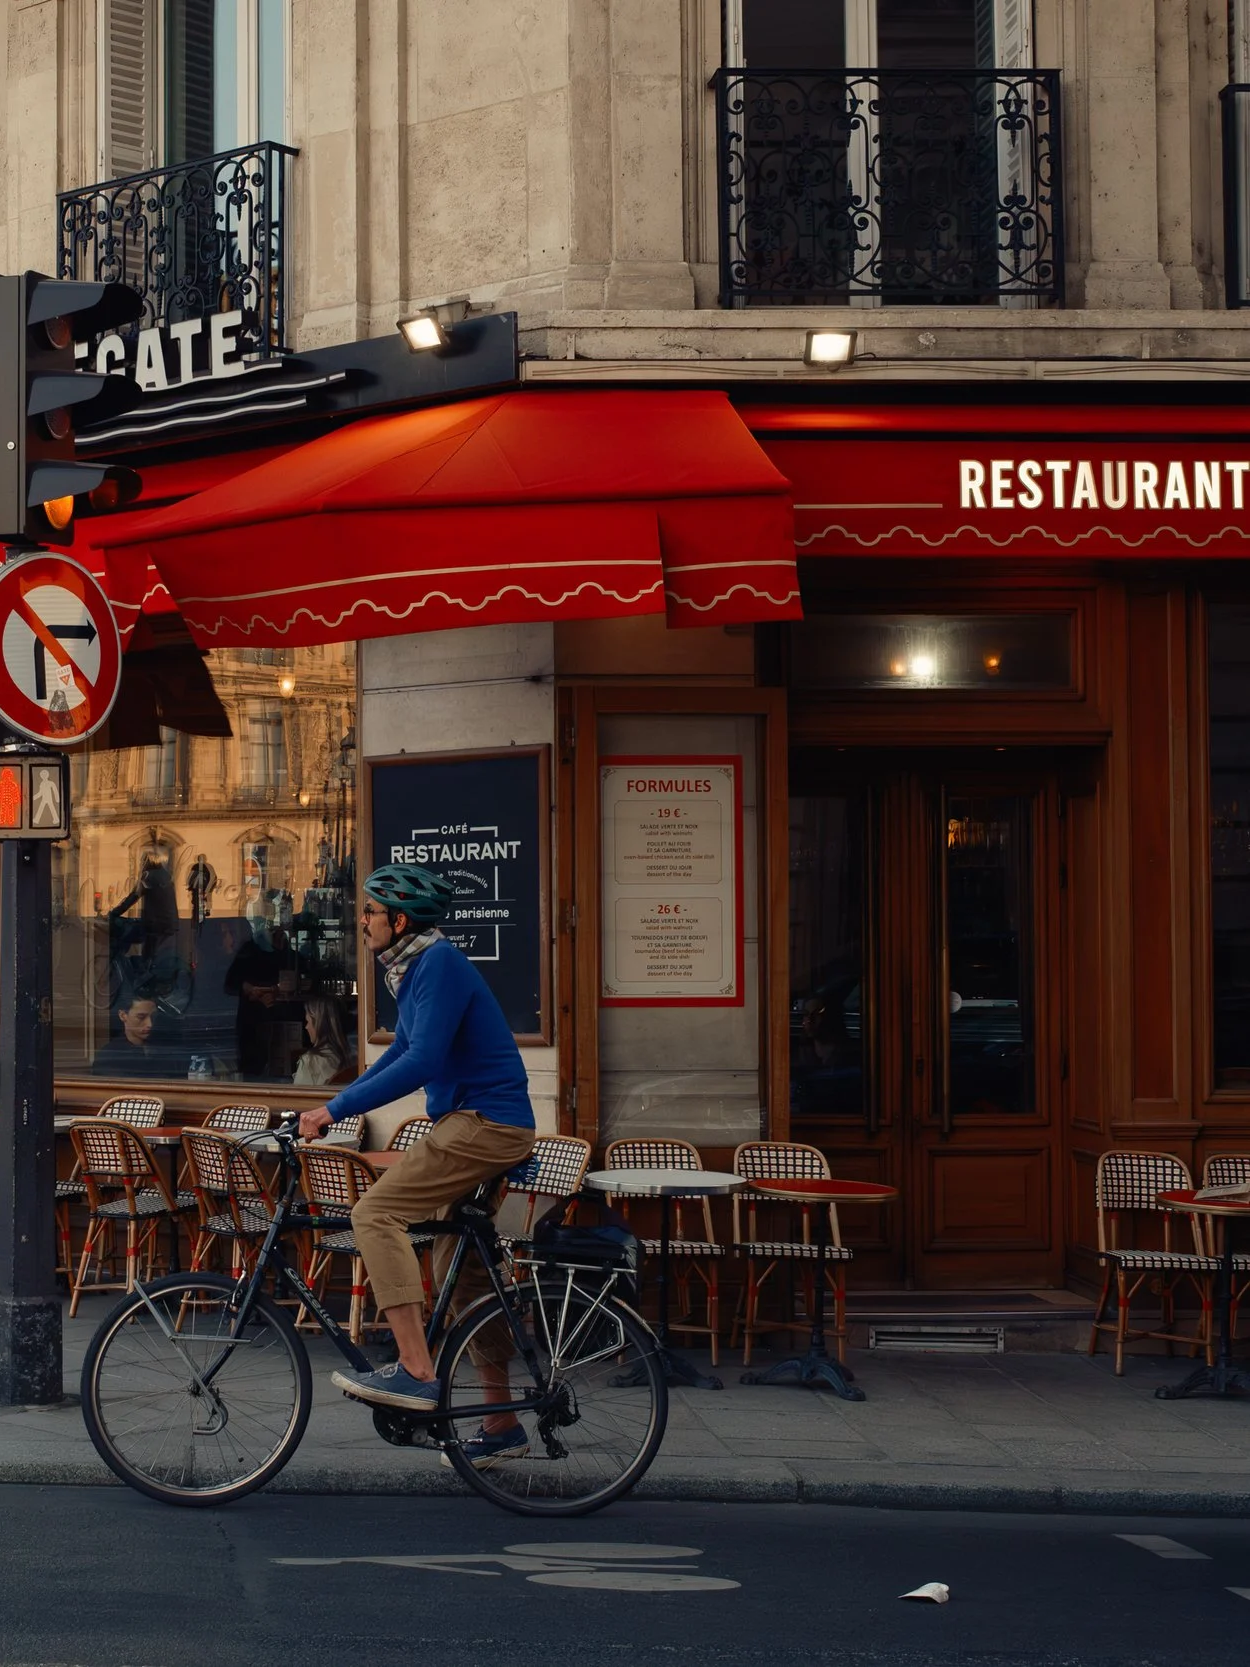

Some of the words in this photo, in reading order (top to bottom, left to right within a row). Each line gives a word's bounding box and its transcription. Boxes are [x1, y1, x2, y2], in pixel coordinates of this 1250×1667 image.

[959, 460, 1250, 509] RESTAURANT
[627, 779, 712, 793] FORMULES
[658, 808, 670, 818] 19
[674, 808, 680, 818] €
[441, 823, 468, 835] CAFÉ
[391, 841, 521, 863] RESTAURANT
[448, 870, 488, 888] traditionnelle
[455, 907, 509, 920] parisienne
[658, 905, 670, 914] 26
[674, 905, 680, 914] €
[470, 935, 476, 947] 7
